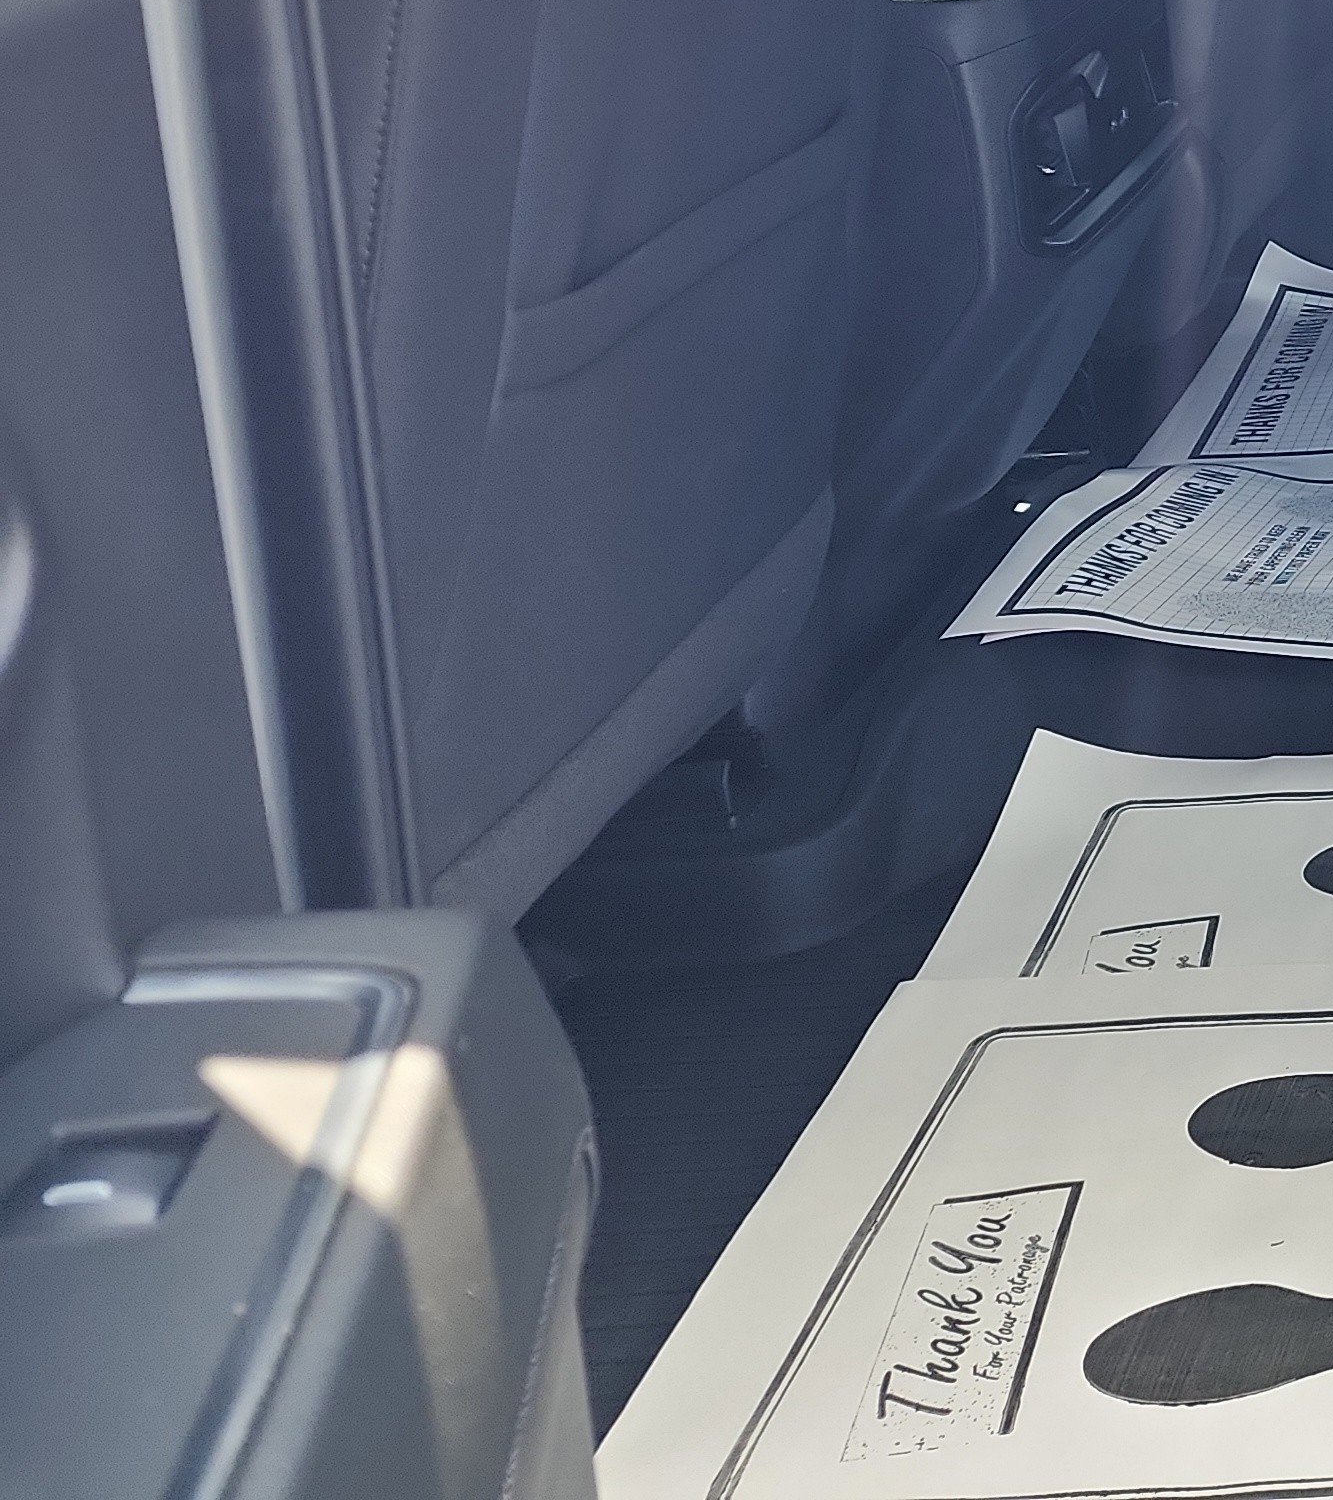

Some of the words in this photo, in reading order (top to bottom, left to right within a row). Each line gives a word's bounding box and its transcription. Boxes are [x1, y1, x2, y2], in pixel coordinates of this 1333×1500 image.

[1275, 318, 1328, 364] COMING
[1260, 366, 1305, 391] FOR
[1230, 394, 1291, 446] THANKS
[1193, 468, 1239, 485] IN
[1145, 482, 1225, 530] COMING
[1116, 522, 1177, 553] FOR
[1055, 543, 1149, 597] THANKS
[929, 1213, 1012, 1274] You
[996, 1234, 1051, 1308] Patronage
[984, 1311, 1018, 1346] Your
[877, 1287, 984, 1419] Thank
[972, 1351, 1005, 1381] For
